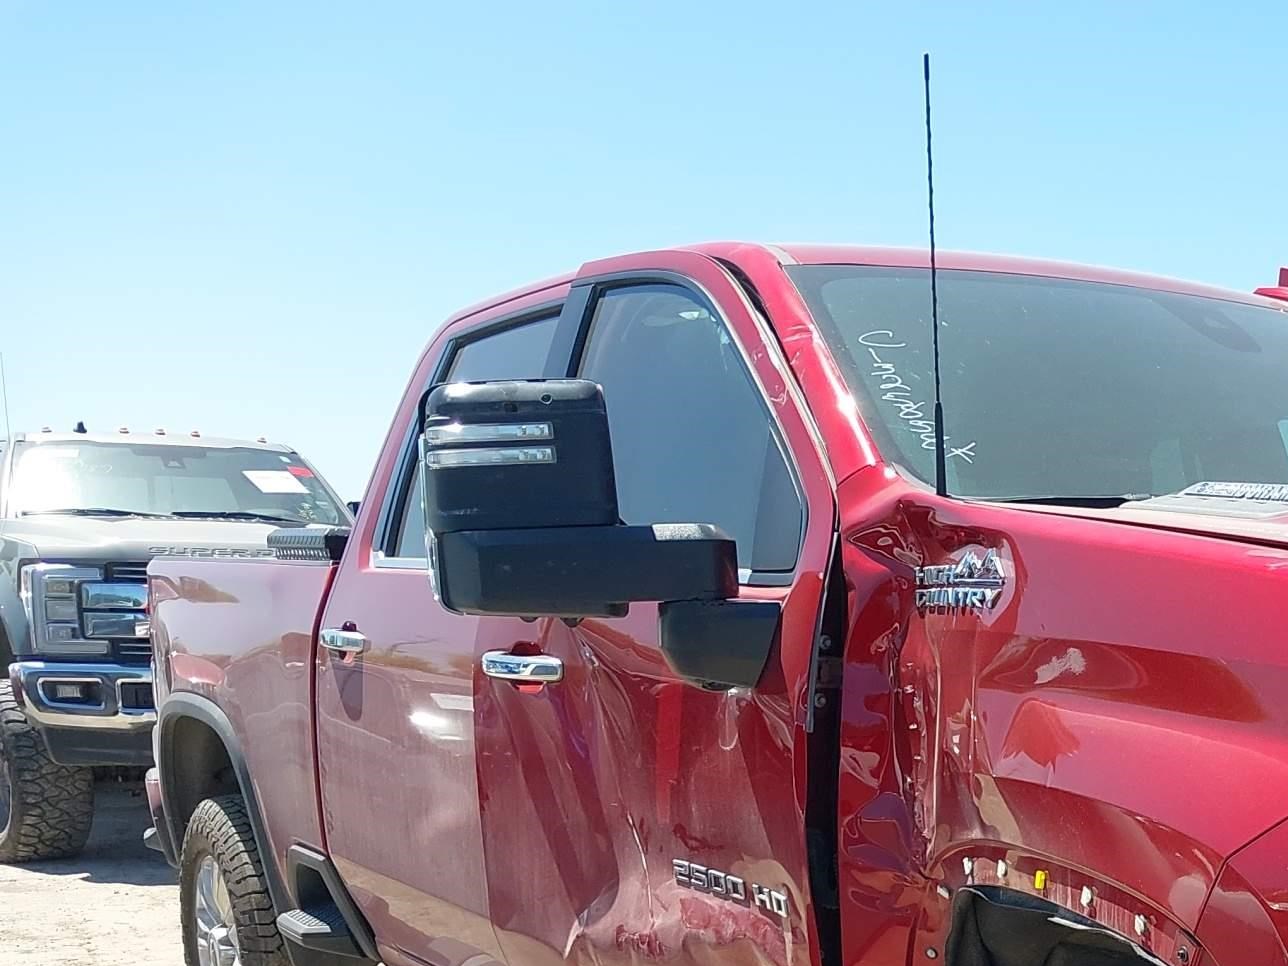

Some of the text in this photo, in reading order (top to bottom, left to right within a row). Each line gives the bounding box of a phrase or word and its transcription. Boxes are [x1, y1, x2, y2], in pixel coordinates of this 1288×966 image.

[149, 546, 249, 558] SUPER
[914, 565, 958, 586] HIGH
[915, 586, 1002, 609] COUNTRY
[672, 858, 789, 918] 2500 HD
